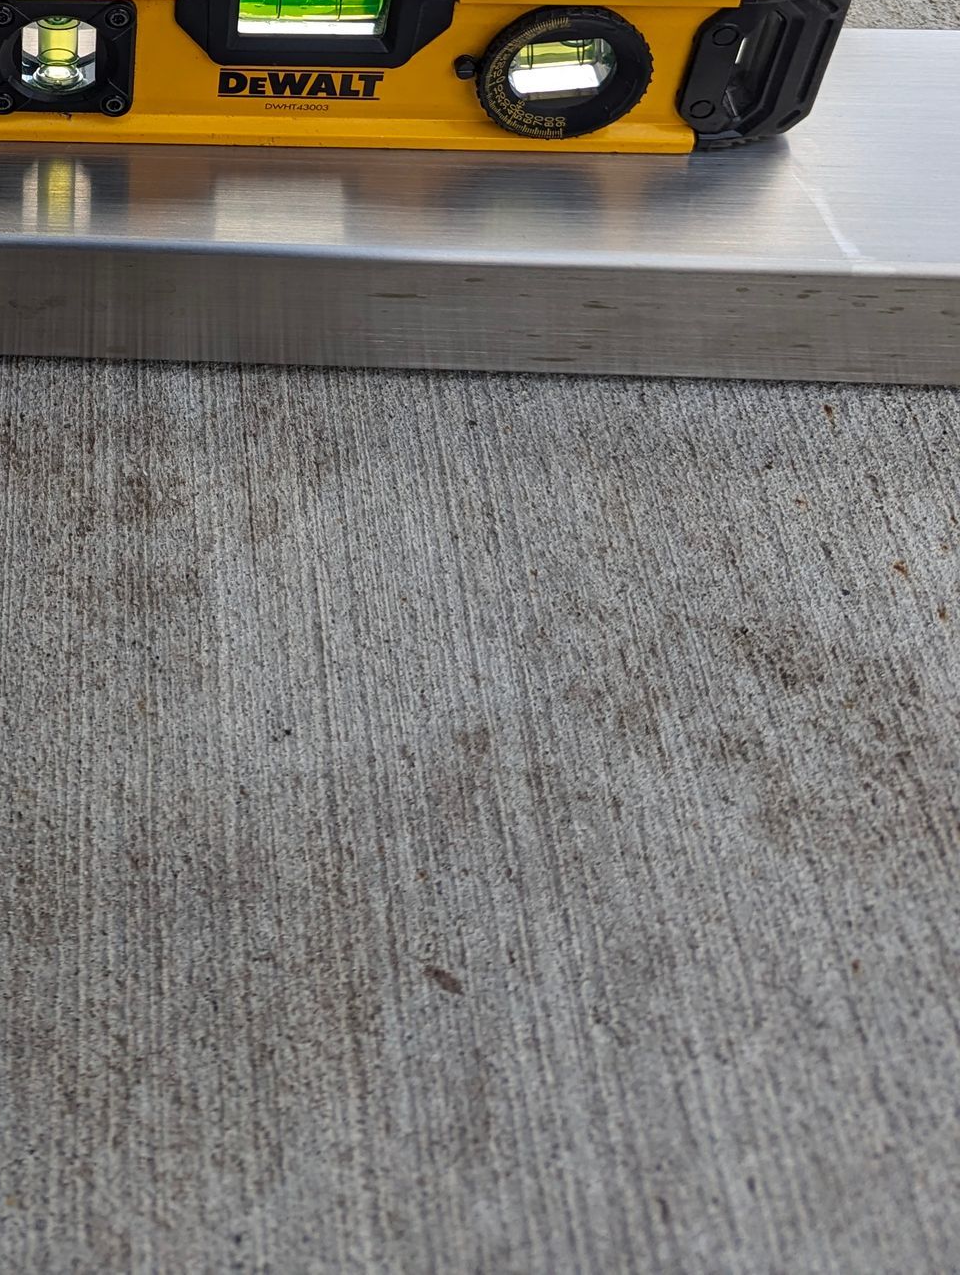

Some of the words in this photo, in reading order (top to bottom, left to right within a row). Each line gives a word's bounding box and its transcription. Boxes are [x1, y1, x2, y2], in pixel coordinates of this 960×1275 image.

[218, 71, 384, 97] DEWALT
[264, 102, 330, 111] DWHT43003
[493, 84, 503, 95] 10
[523, 113, 533, 124] 60
[533, 115, 544, 126] 70
[544, 116, 554, 127] 80
[555, 116, 566, 127] 90
